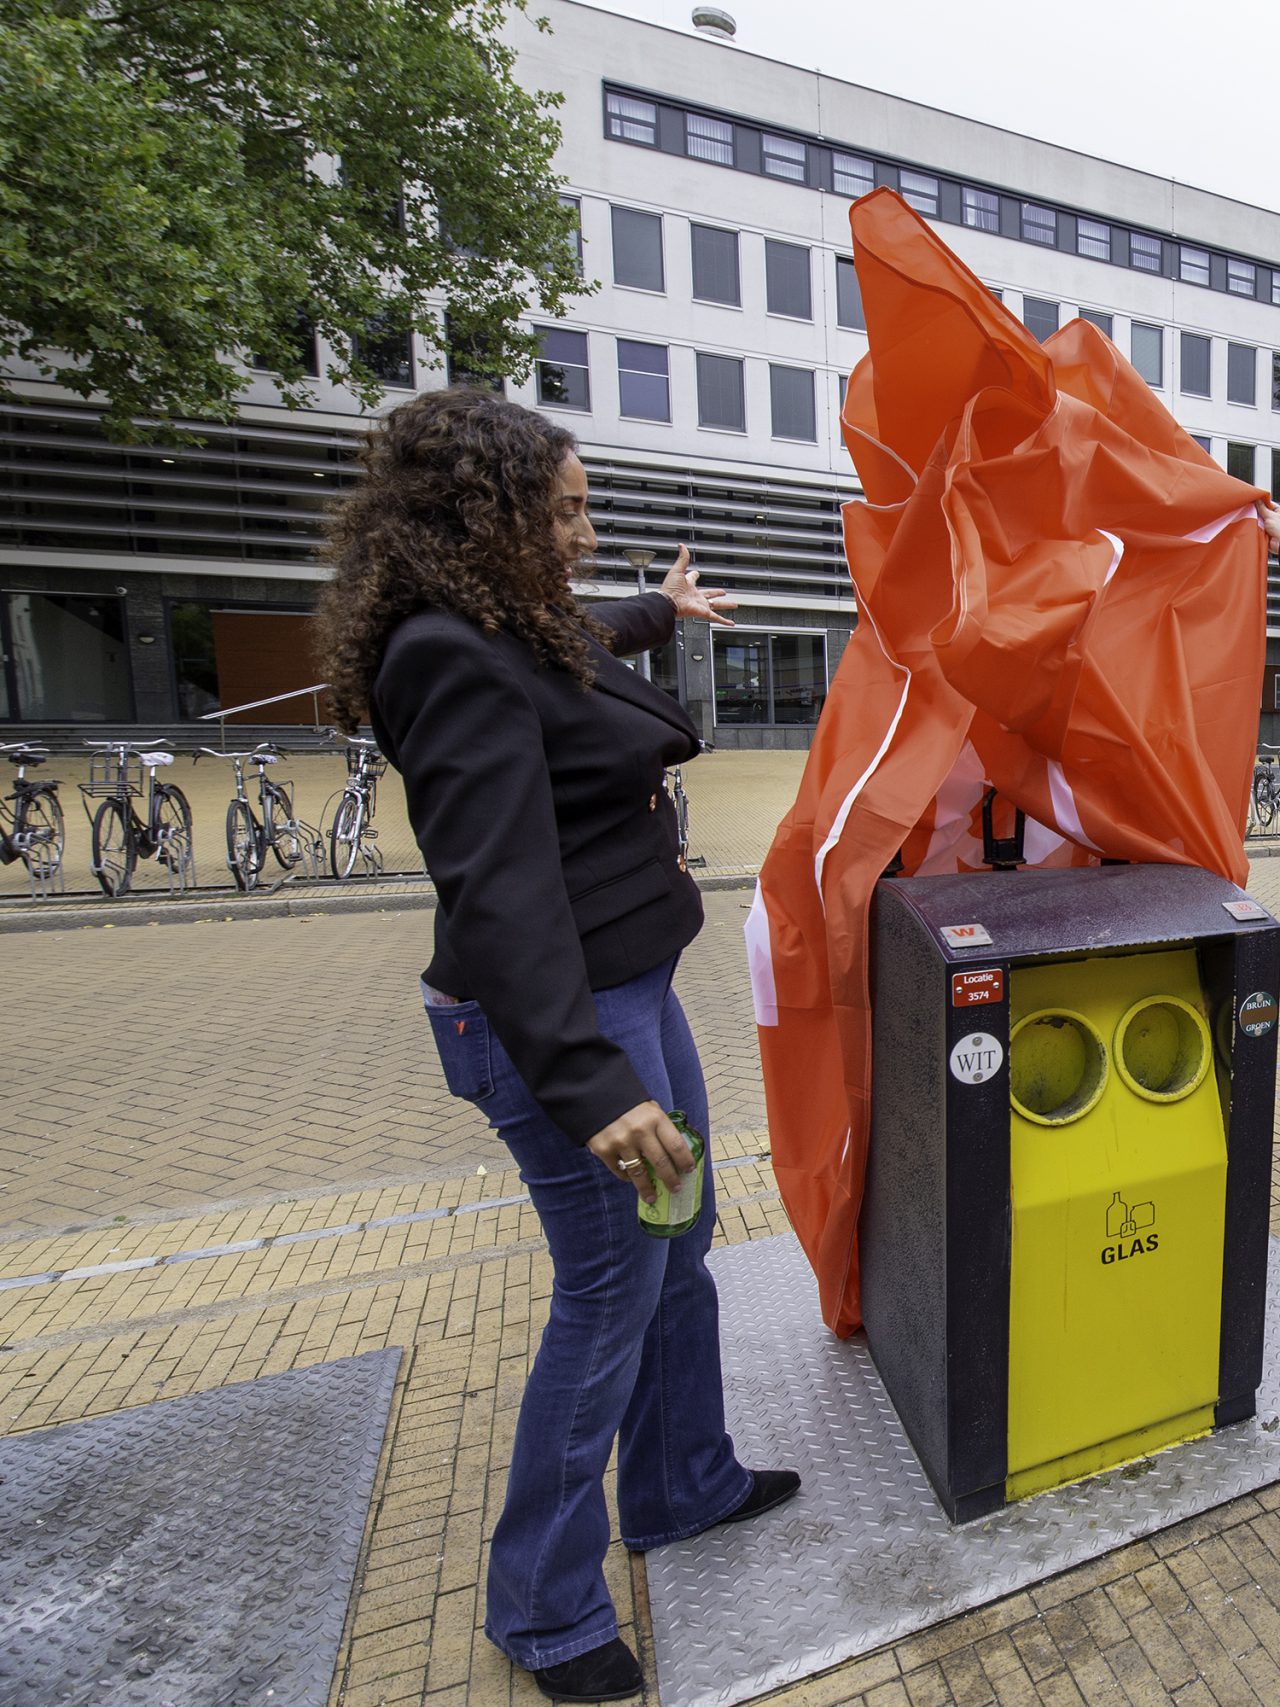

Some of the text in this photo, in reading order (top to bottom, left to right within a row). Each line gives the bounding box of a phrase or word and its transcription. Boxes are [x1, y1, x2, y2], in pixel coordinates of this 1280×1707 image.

[951, 927, 975, 937] W
[963, 974, 994, 985] Locatie
[967, 991, 989, 1002] 3574
[1246, 1000, 1271, 1010] BRUIN
[1246, 1021, 1270, 1032] GROEN
[956, 1050, 996, 1073] WIT
[1101, 1233, 1159, 1265] GLAS
